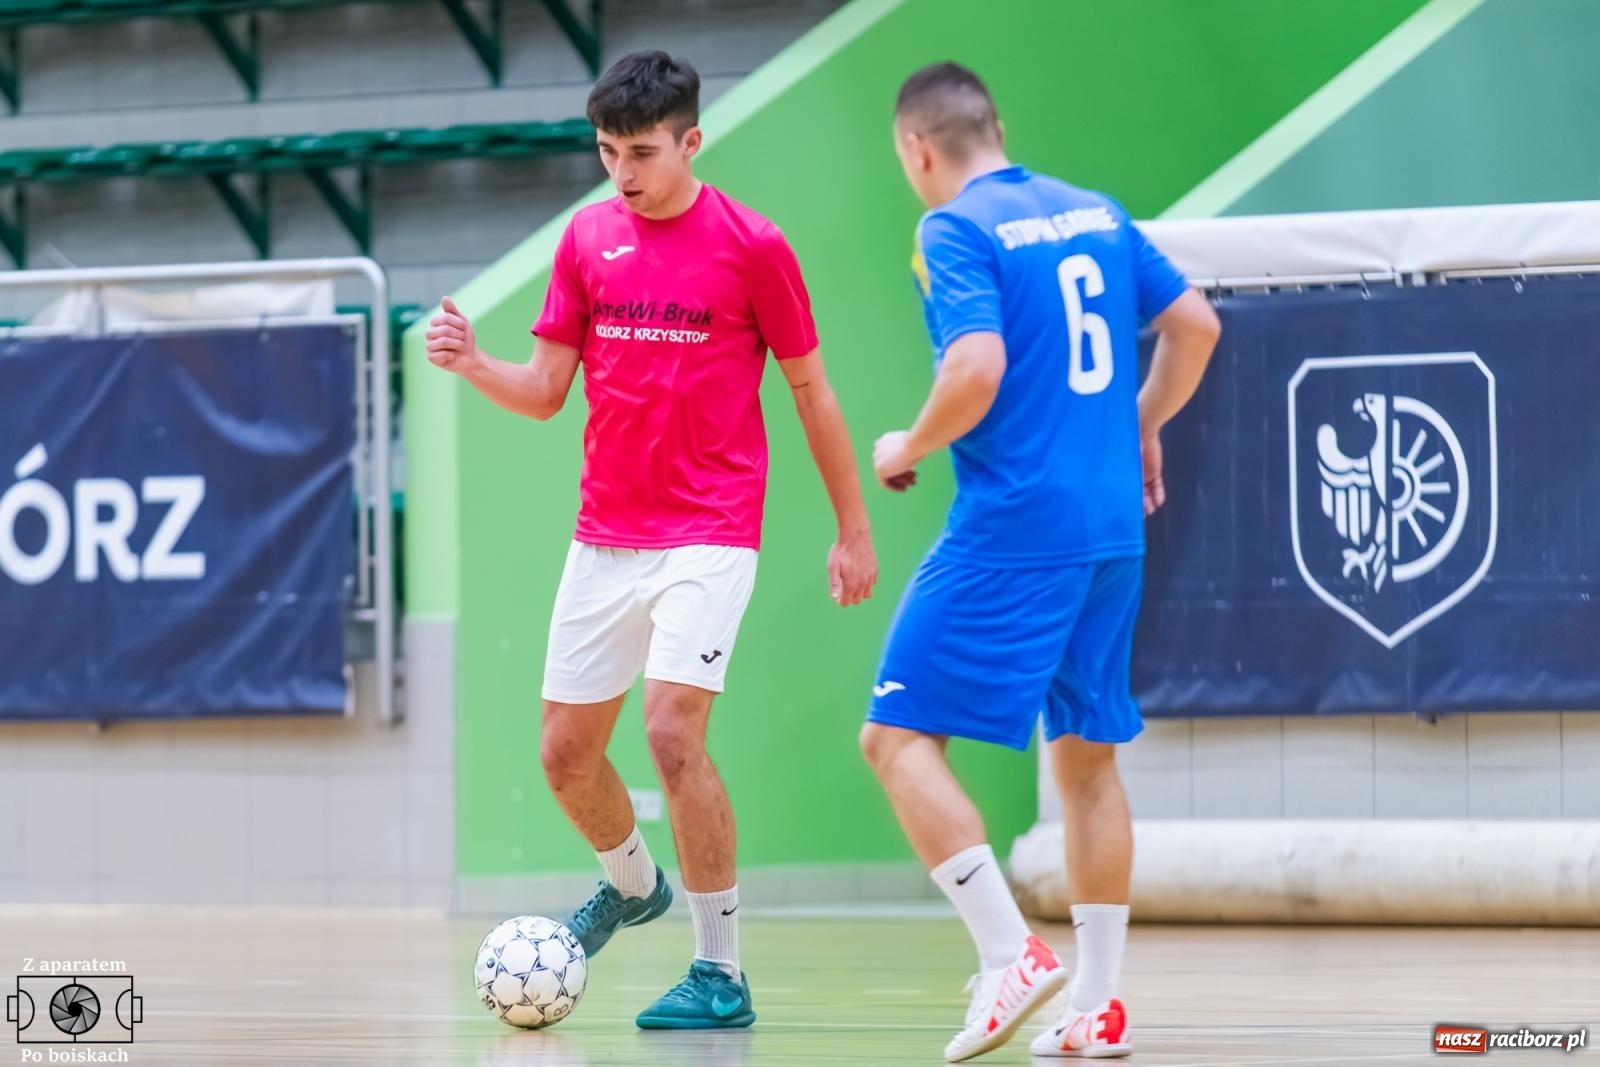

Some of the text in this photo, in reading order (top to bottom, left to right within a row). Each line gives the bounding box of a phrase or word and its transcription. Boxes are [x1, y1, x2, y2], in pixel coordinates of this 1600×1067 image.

[633, 327, 710, 343] KRZYSZTOF
[1057, 253, 1114, 395] 6
[0, 442, 206, 585] ÓRZ
